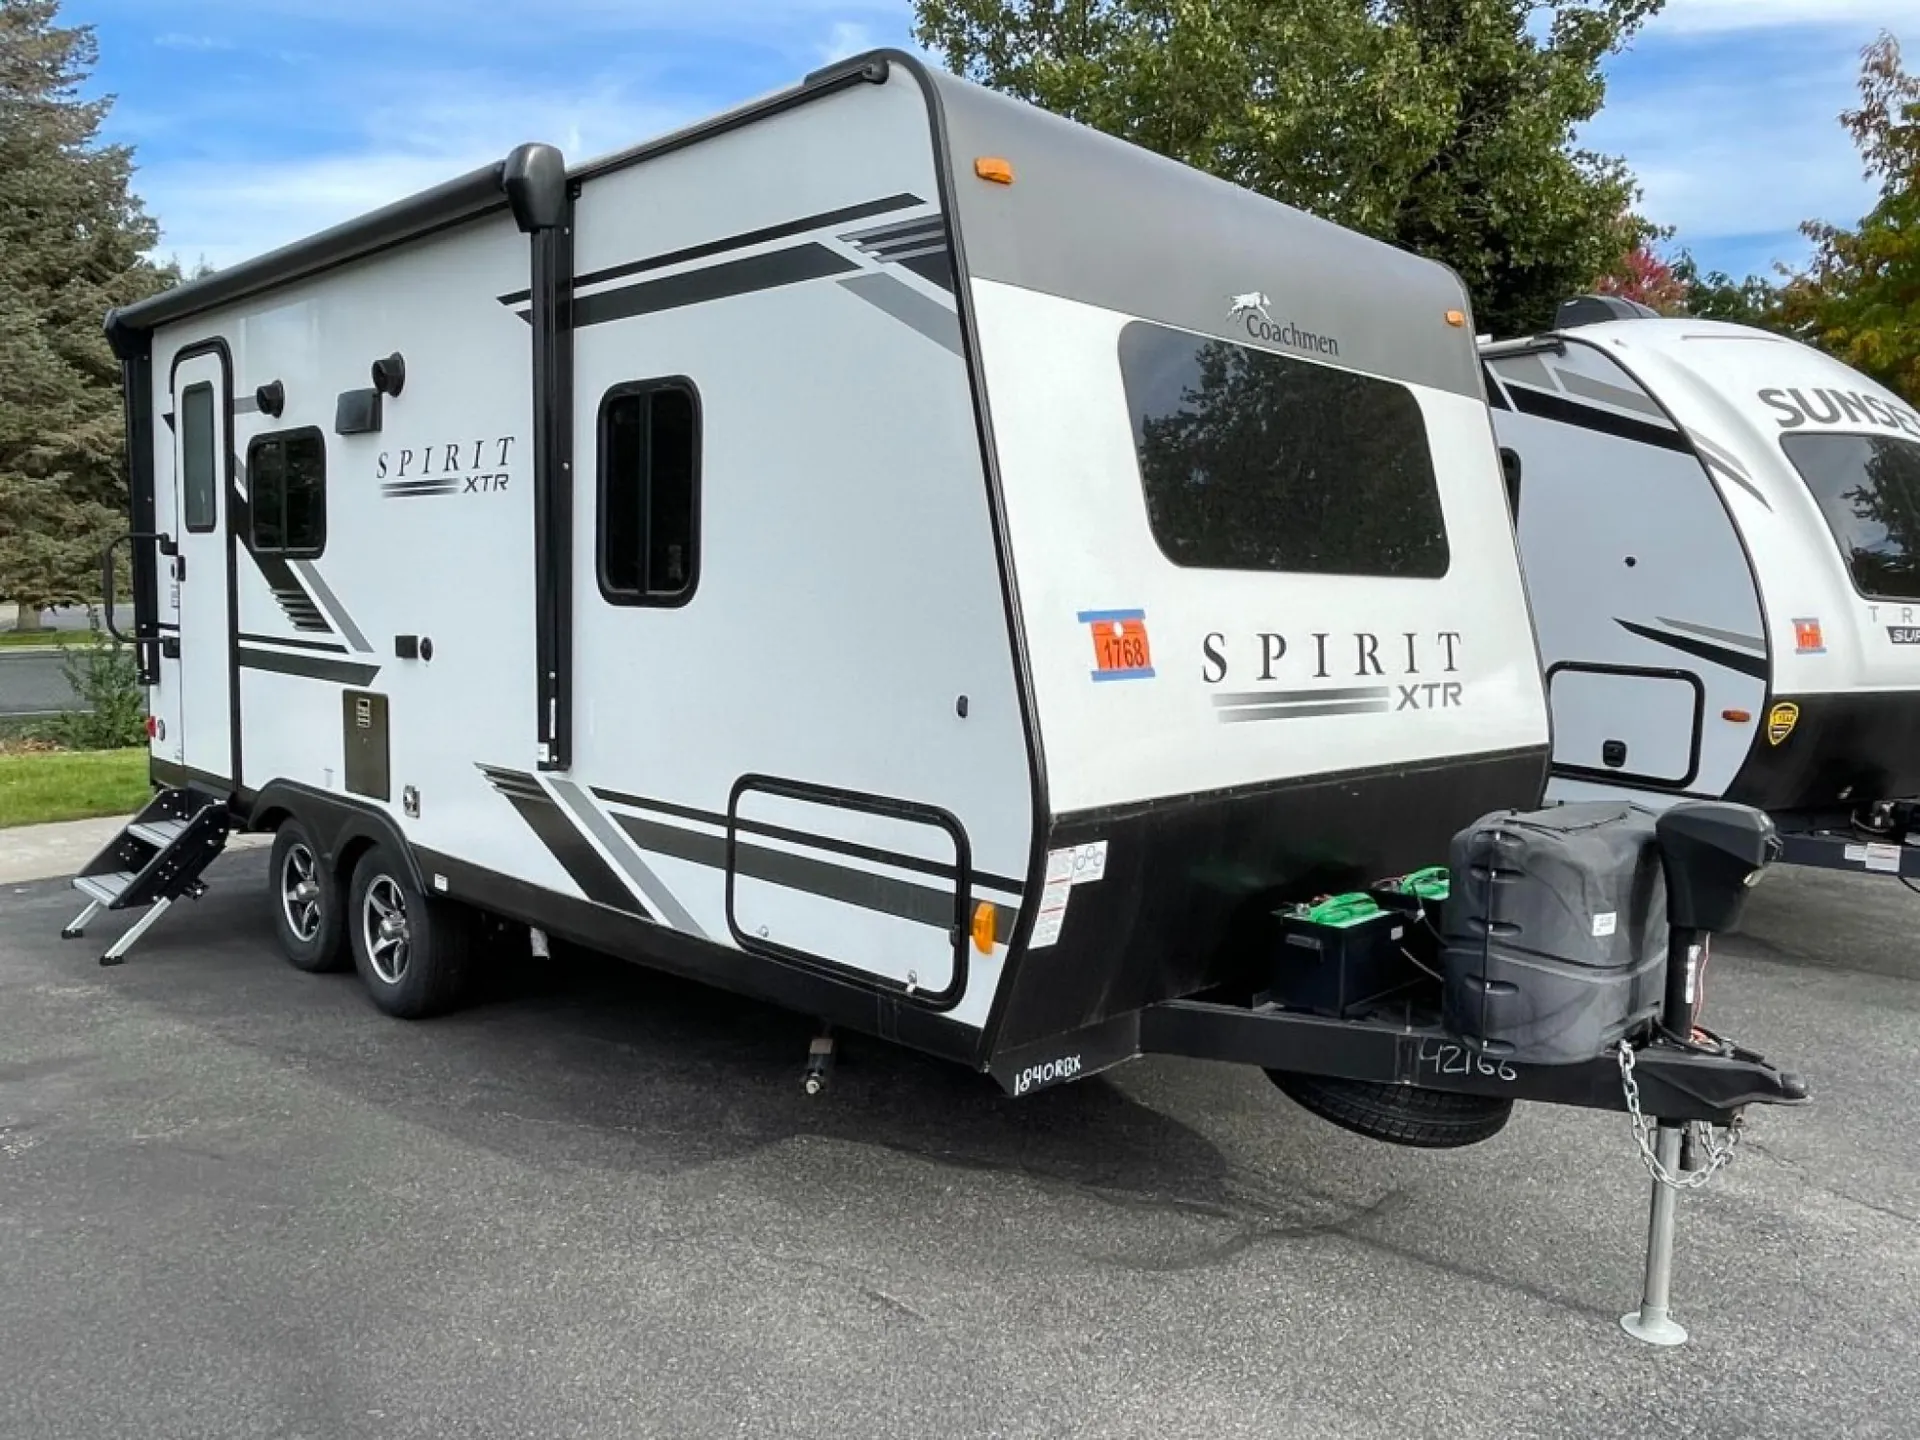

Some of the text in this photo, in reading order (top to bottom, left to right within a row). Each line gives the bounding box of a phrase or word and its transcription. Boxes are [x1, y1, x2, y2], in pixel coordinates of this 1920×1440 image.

[1246, 314, 1340, 356] Coachmen
[376, 436, 515, 479] SPIRIT
[462, 473, 510, 494] XTR
[1104, 637, 1145, 669] 1768
[1202, 631, 1462, 684] SPIRIT
[1396, 681, 1463, 711] XTR
[1419, 1036, 1517, 1081] 42166
